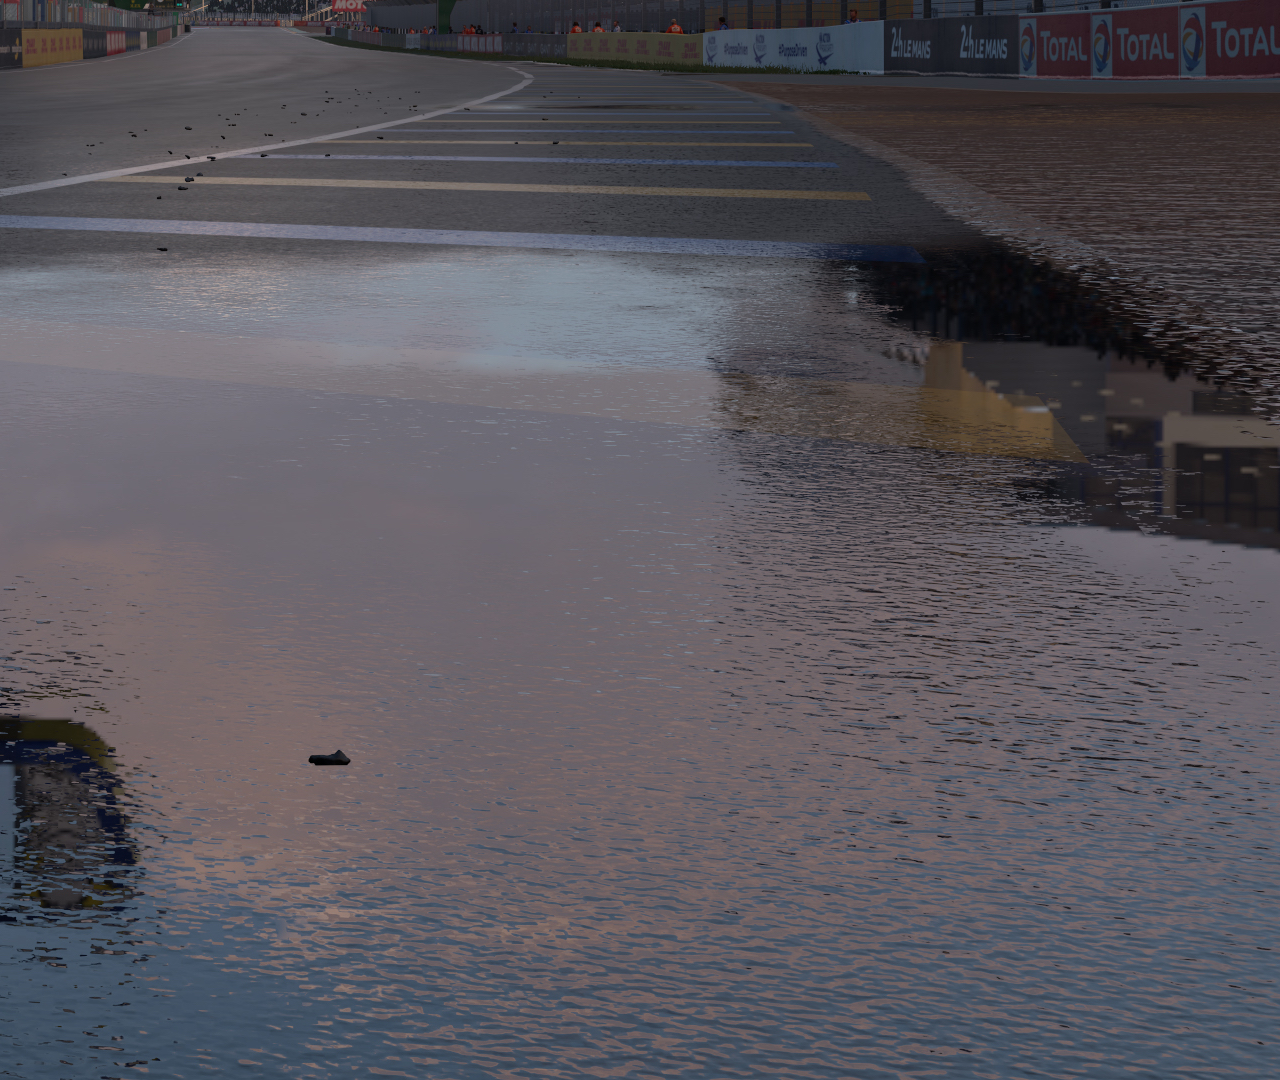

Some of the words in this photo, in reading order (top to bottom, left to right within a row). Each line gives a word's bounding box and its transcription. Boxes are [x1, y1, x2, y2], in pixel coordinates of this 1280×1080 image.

[334, 0, 367, 10] MOT
[903, 40, 912, 58] LE
[912, 40, 931, 59] MANS
[975, 39, 985, 59] LE
[985, 38, 1008, 59] MANS
[1040, 30, 1089, 62] TOTAL
[1116, 27, 1174, 62] TOTAL
[1212, 21, 1280, 58] TOTAL
